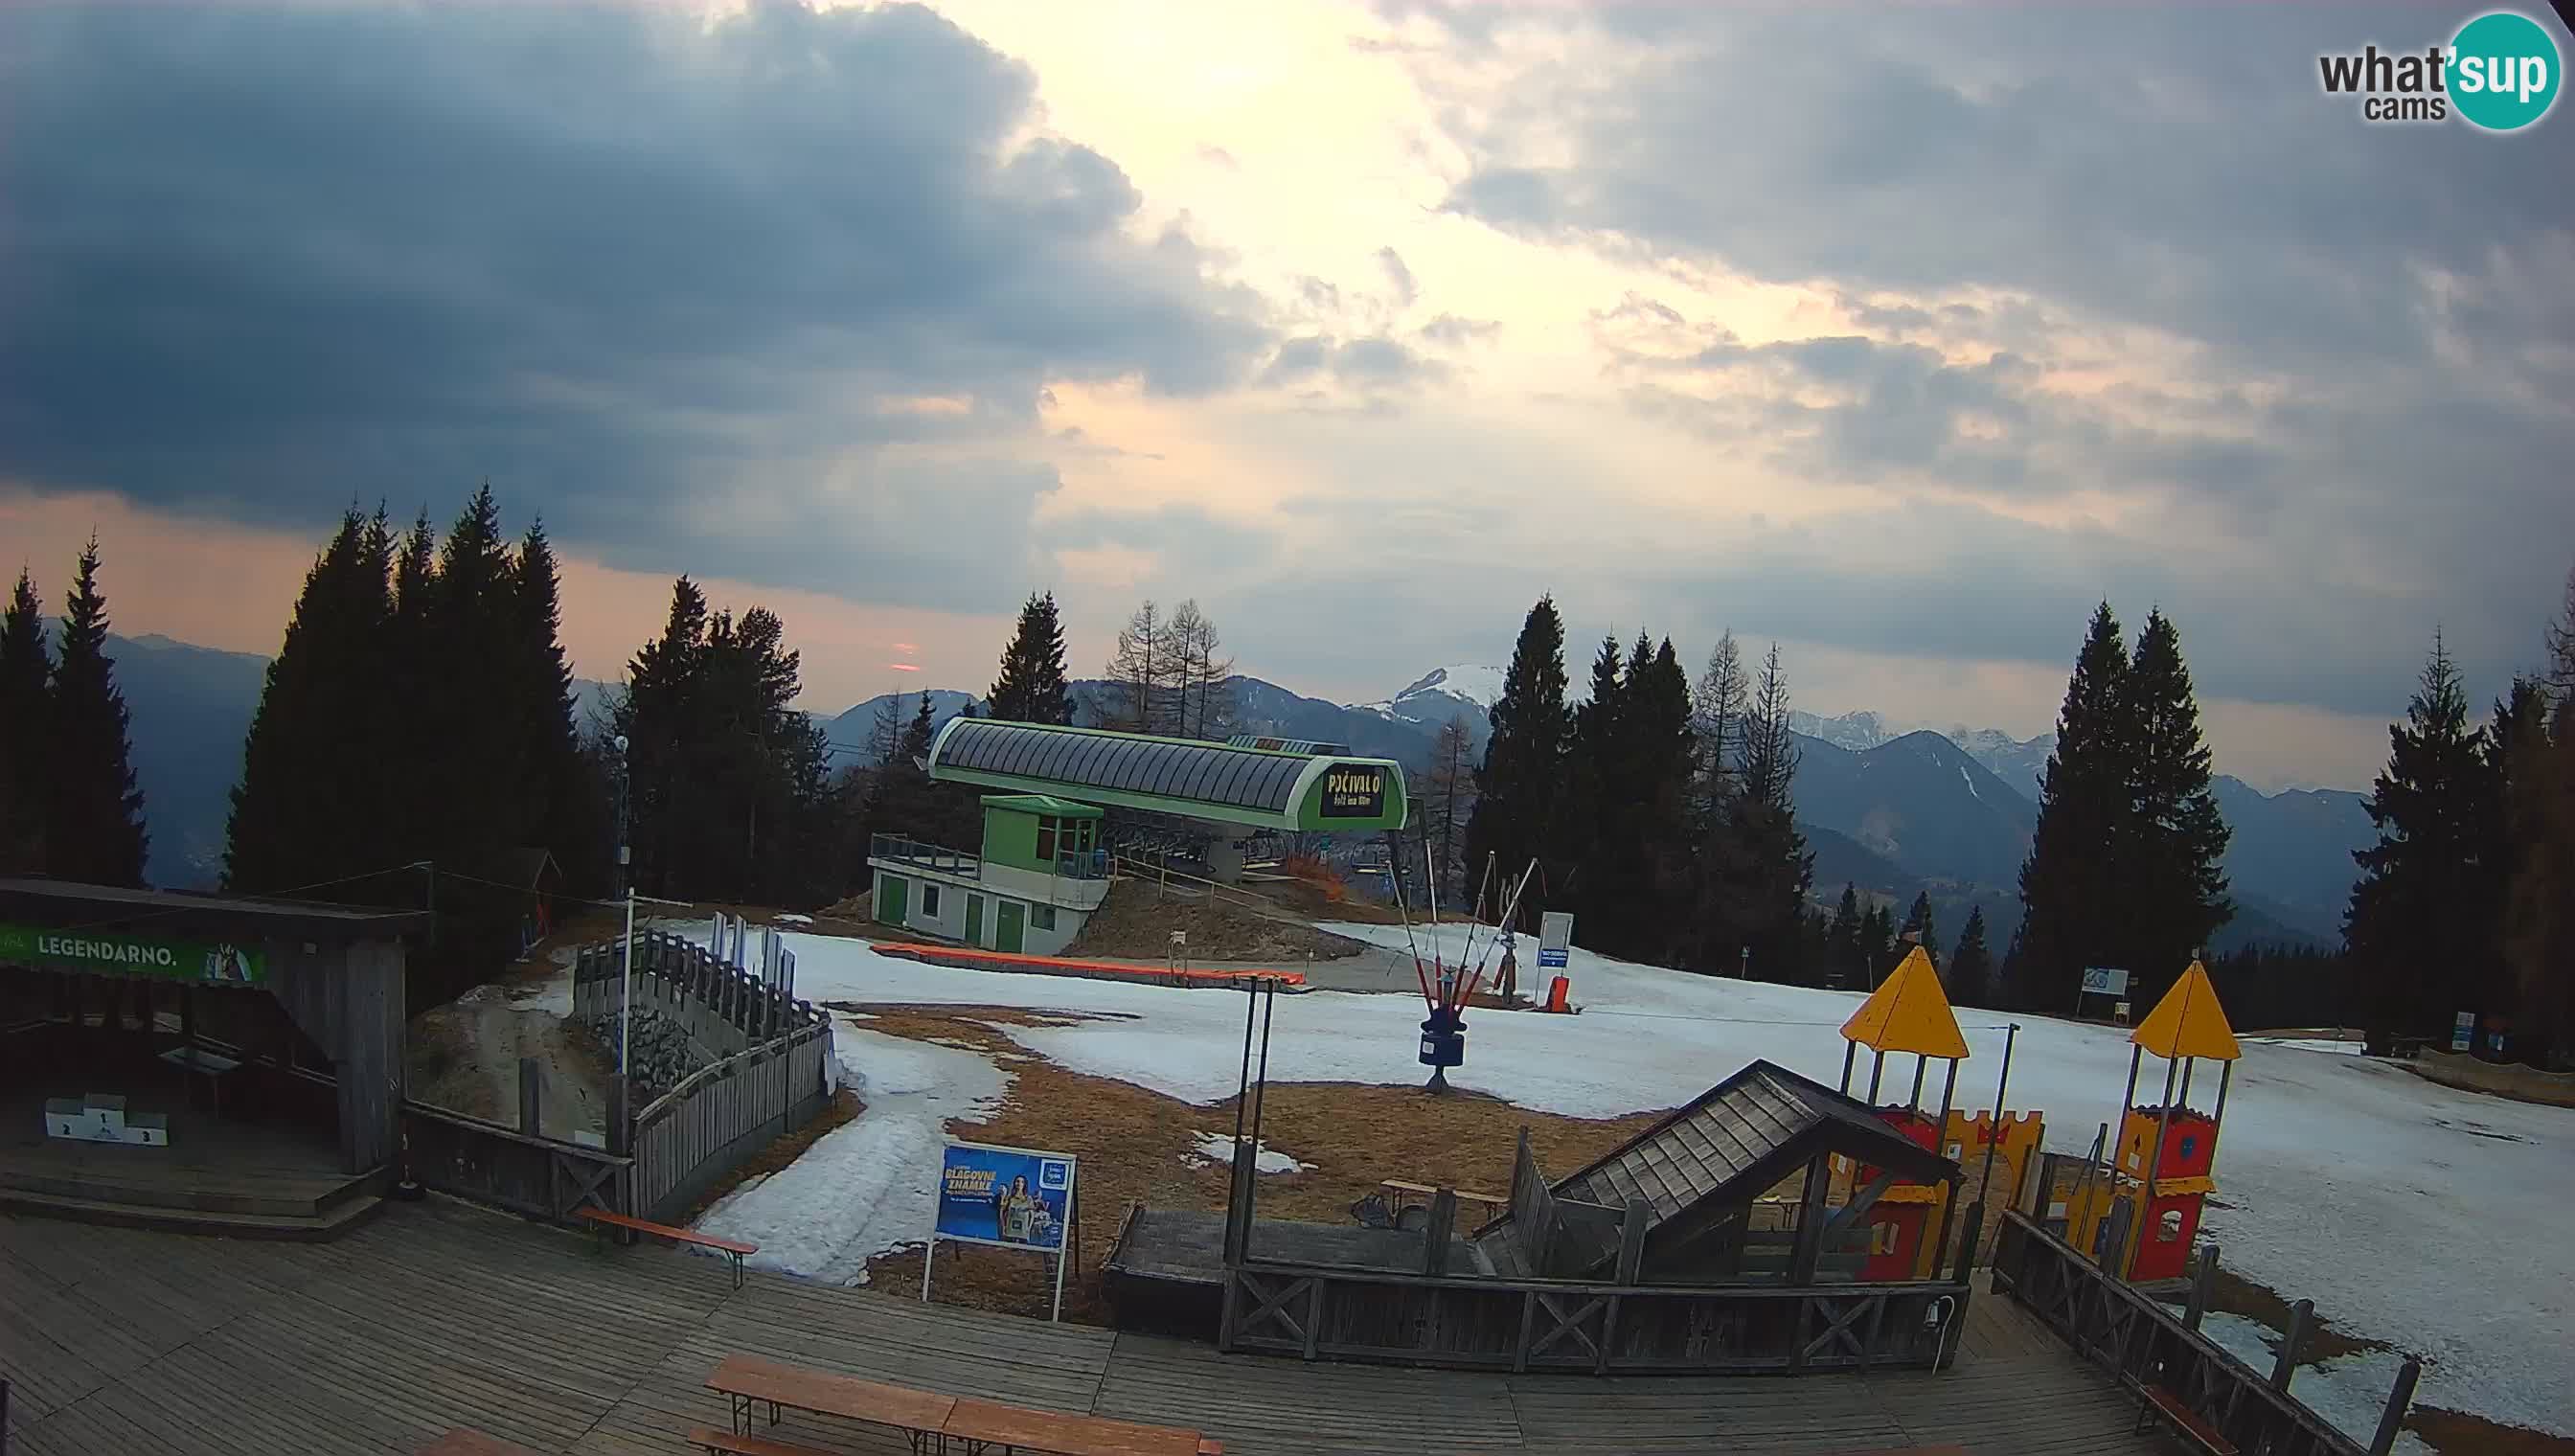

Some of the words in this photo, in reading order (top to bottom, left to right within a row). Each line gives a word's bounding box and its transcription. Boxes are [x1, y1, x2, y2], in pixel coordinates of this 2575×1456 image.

[38, 935, 177, 967] LEGENDARNO.
[101, 1112, 107, 1124] 1
[62, 1124, 71, 1135] 2
[142, 1130, 150, 1143] 3
